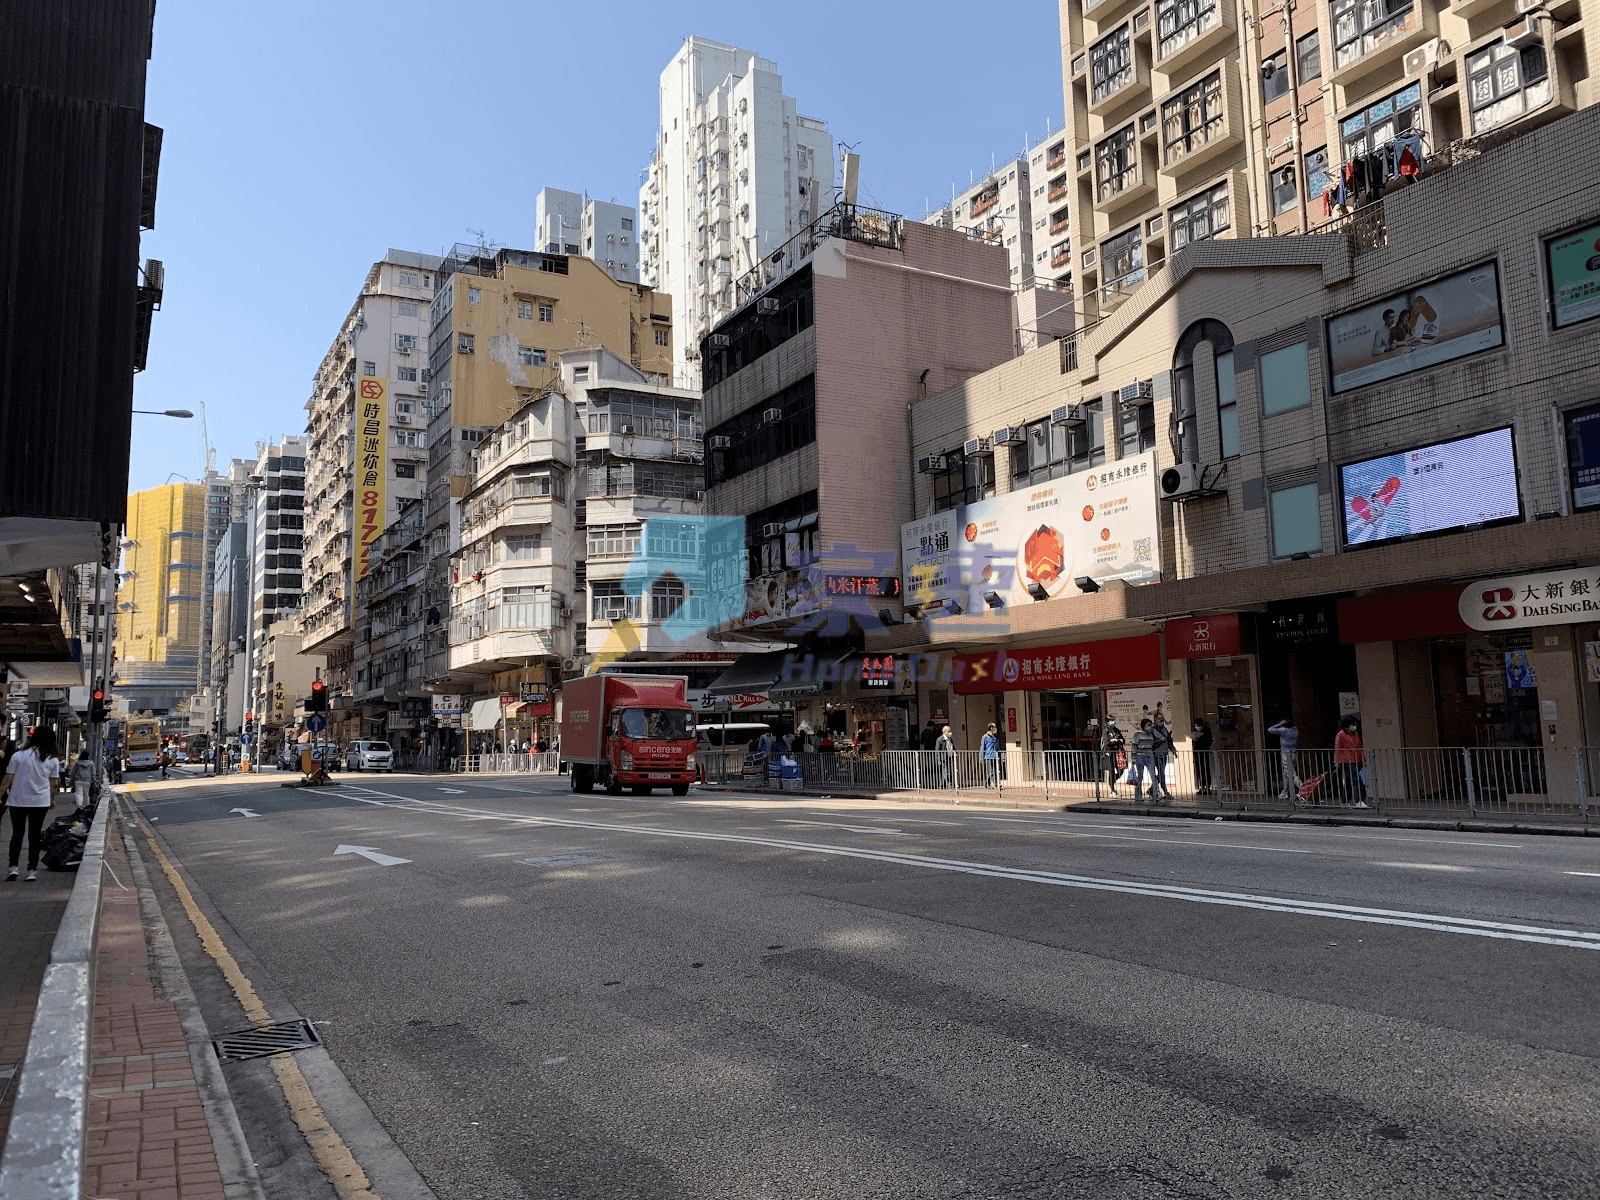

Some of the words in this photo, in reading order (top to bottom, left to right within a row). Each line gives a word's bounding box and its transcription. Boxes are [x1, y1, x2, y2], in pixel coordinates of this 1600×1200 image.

[362, 402, 381, 487] 時昌迷你倉
[1100, 462, 1148, 484] 招商永隆銀行
[905, 517, 950, 540] 招商永隆銀行
[906, 531, 951, 558] 一點通
[1582, 599, 1600, 612] BA
[1188, 642, 1217, 653] 大新銀行
[1022, 654, 1090, 675] 招商永隆銀行
[1054, 672, 1071, 680] LUNG
[638, 746, 671, 754] sincere
